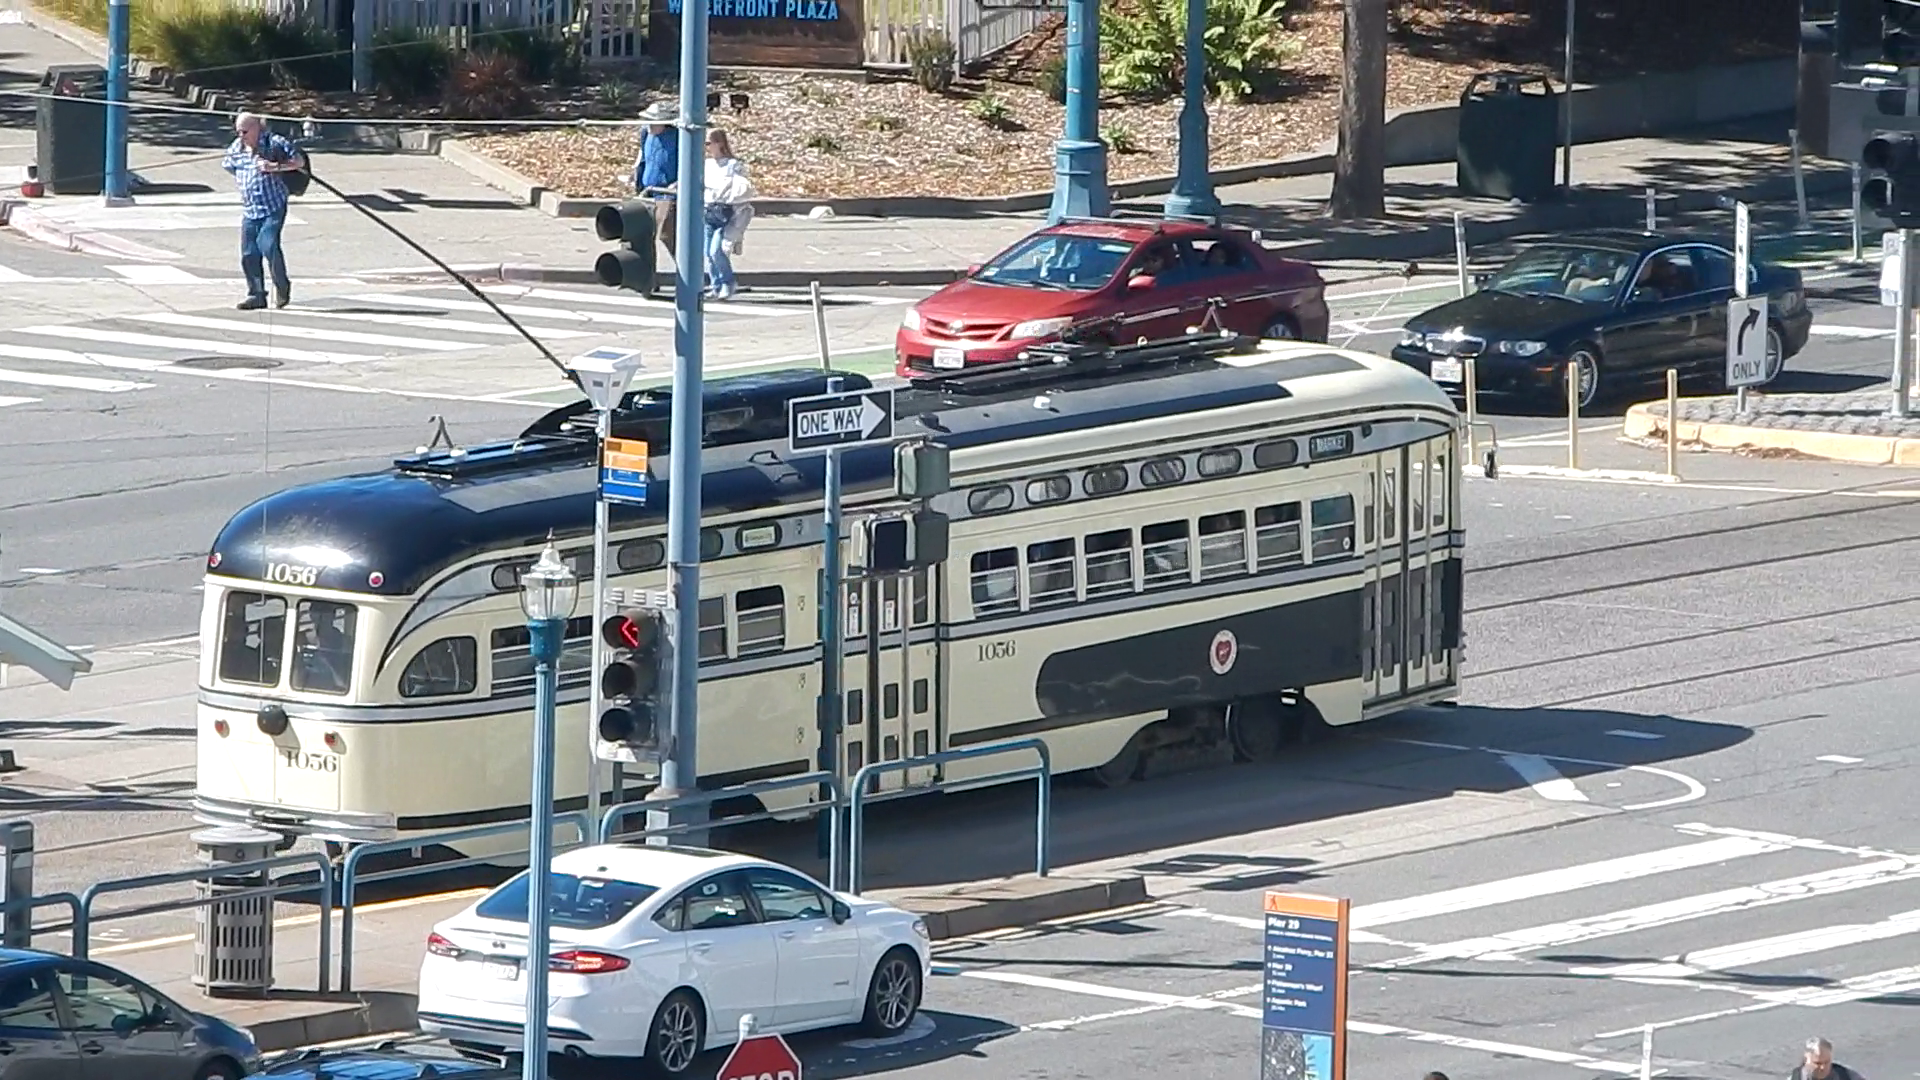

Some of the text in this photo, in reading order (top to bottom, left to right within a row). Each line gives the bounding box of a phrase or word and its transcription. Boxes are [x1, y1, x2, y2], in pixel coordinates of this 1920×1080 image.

[667, 0, 838, 20] WRFRONT PLAZA
[1732, 360, 1761, 380] ONLY
[800, 407, 864, 435] ONE WAY
[262, 562, 318, 586] 1056
[978, 640, 1016, 661] 1056
[285, 750, 337, 773] 1056
[1268, 916, 1286, 928] Pier
